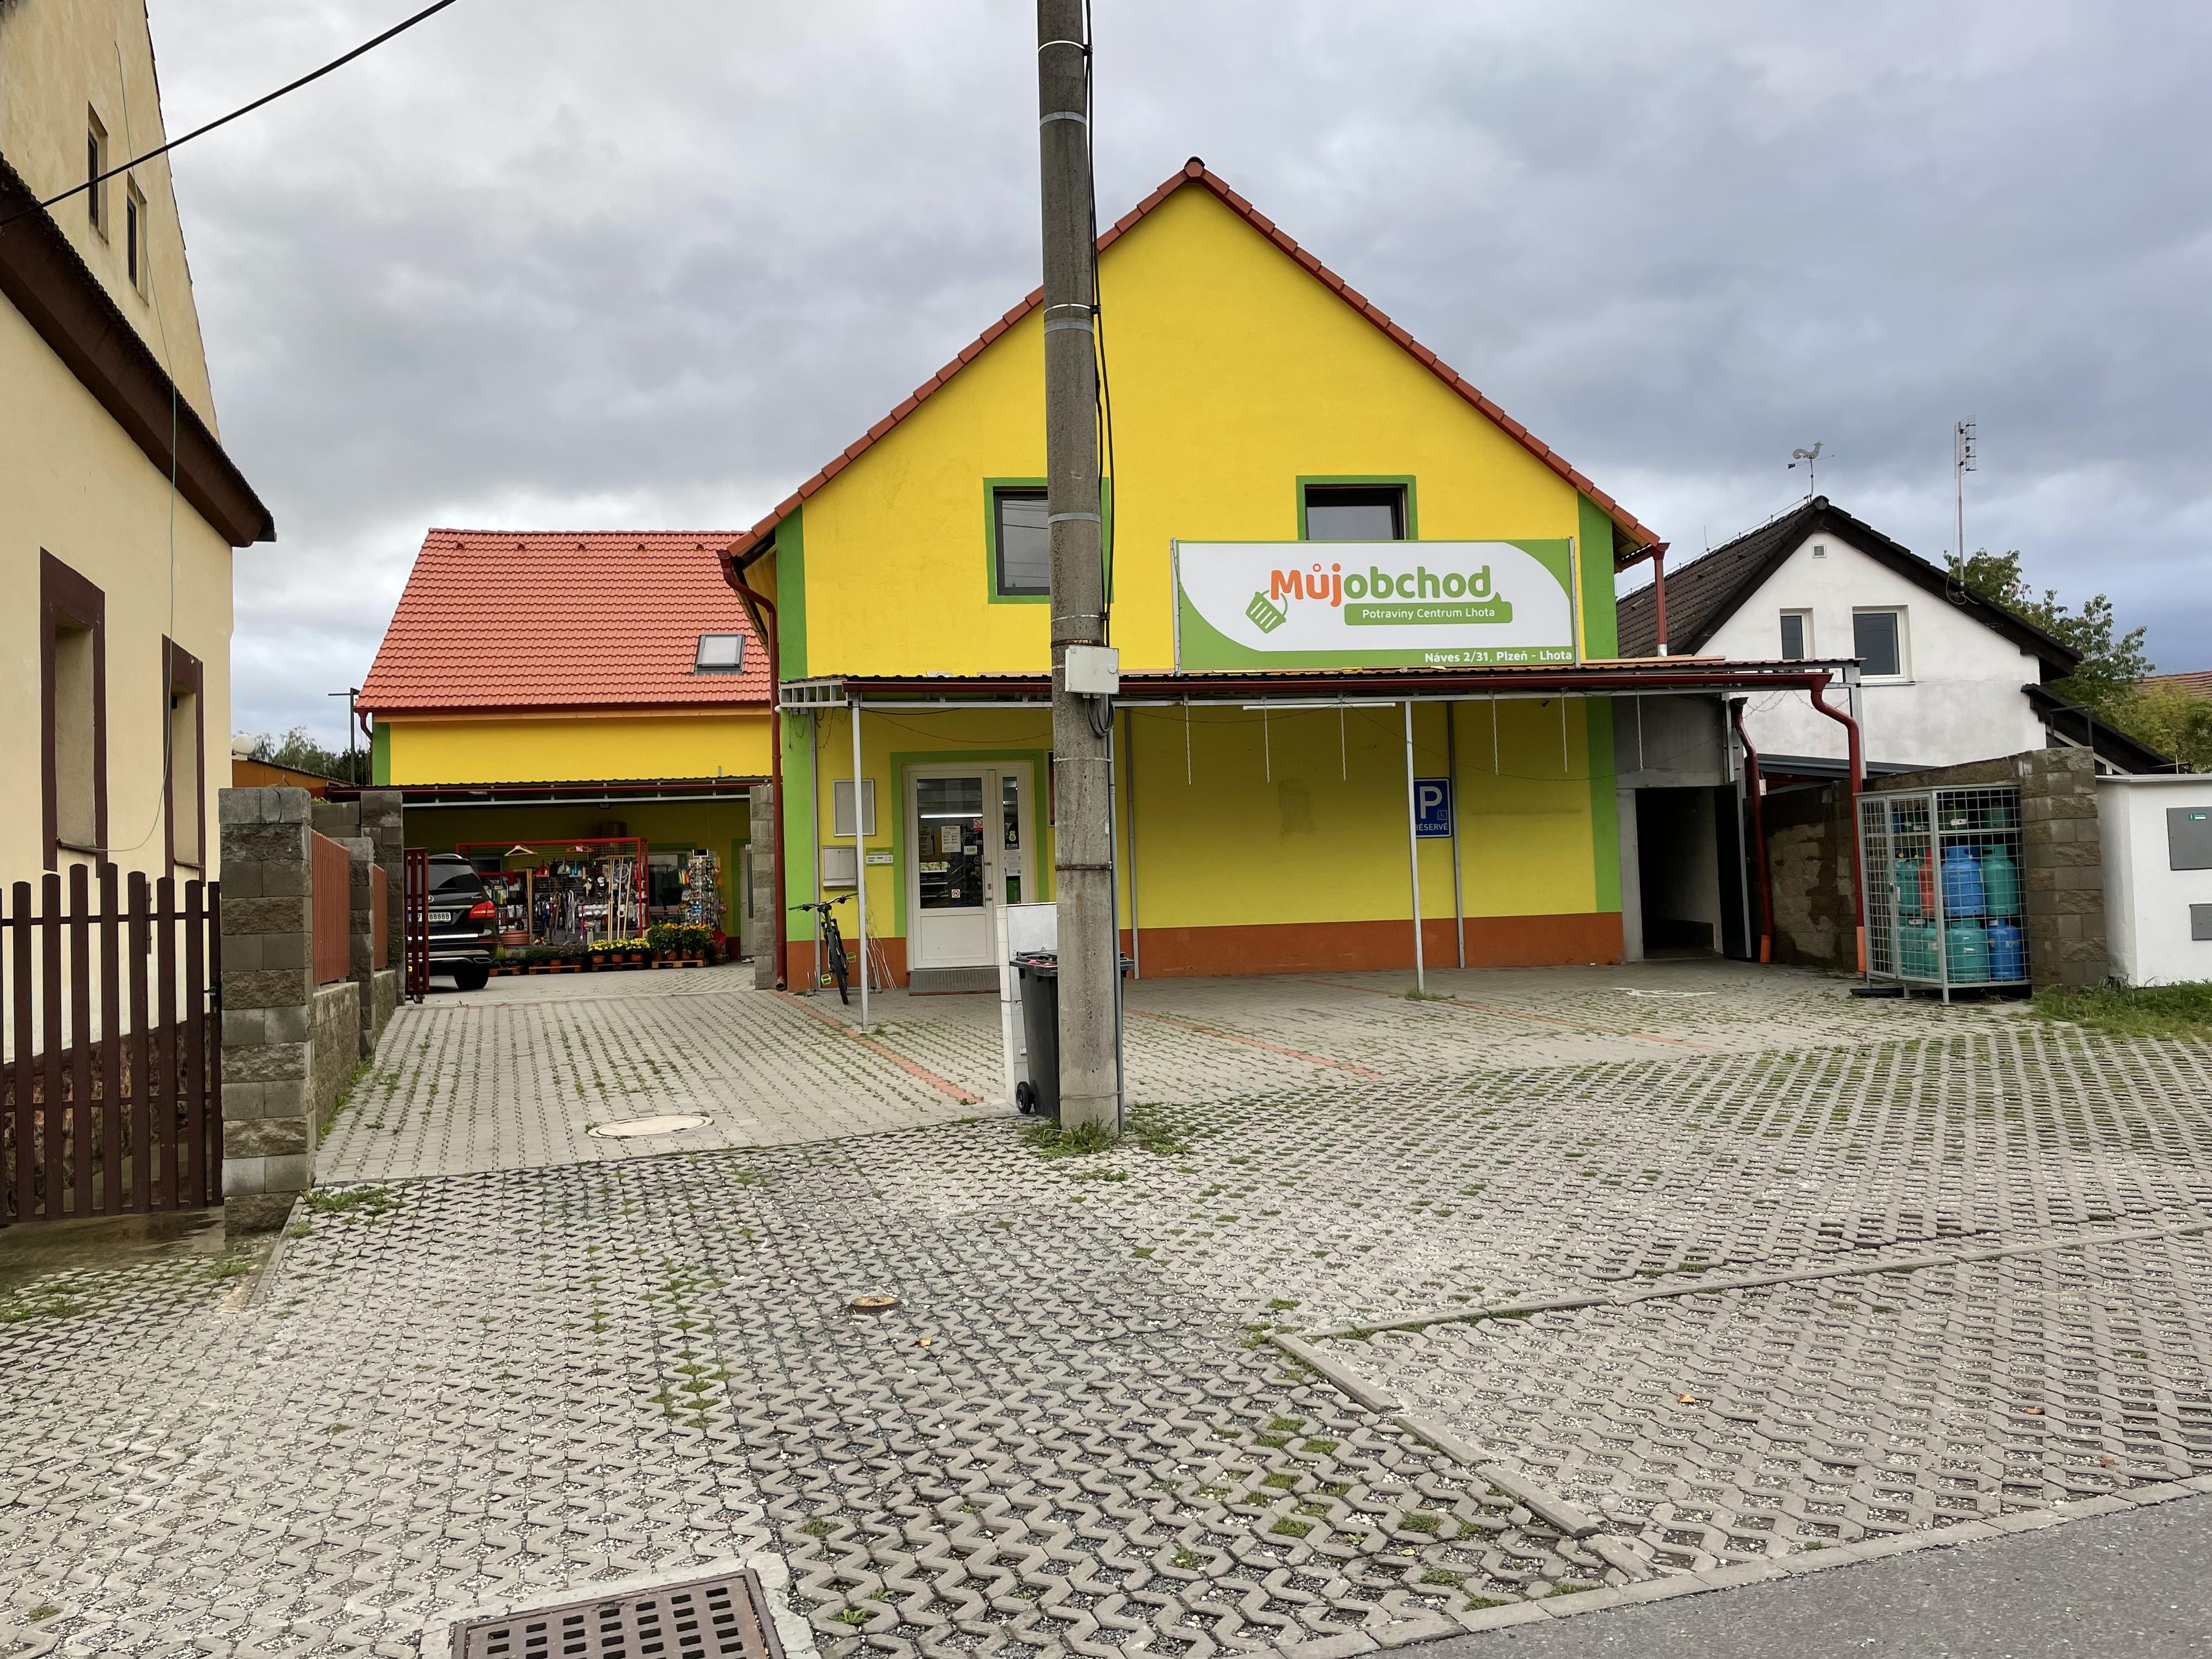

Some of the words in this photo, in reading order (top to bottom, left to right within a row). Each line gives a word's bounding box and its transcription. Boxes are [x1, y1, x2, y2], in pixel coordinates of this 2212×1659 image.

[1362, 609, 1413, 619] Potraviny
[1417, 608, 1462, 618] Centrum
[1465, 608, 1495, 617] Lhota
[1425, 652, 1460, 662] Náves
[1463, 651, 1493, 662] 2/31,
[1496, 651, 1527, 661] Plzeň
[1540, 650, 1572, 660] Lhota
[1420, 786, 1442, 818] P
